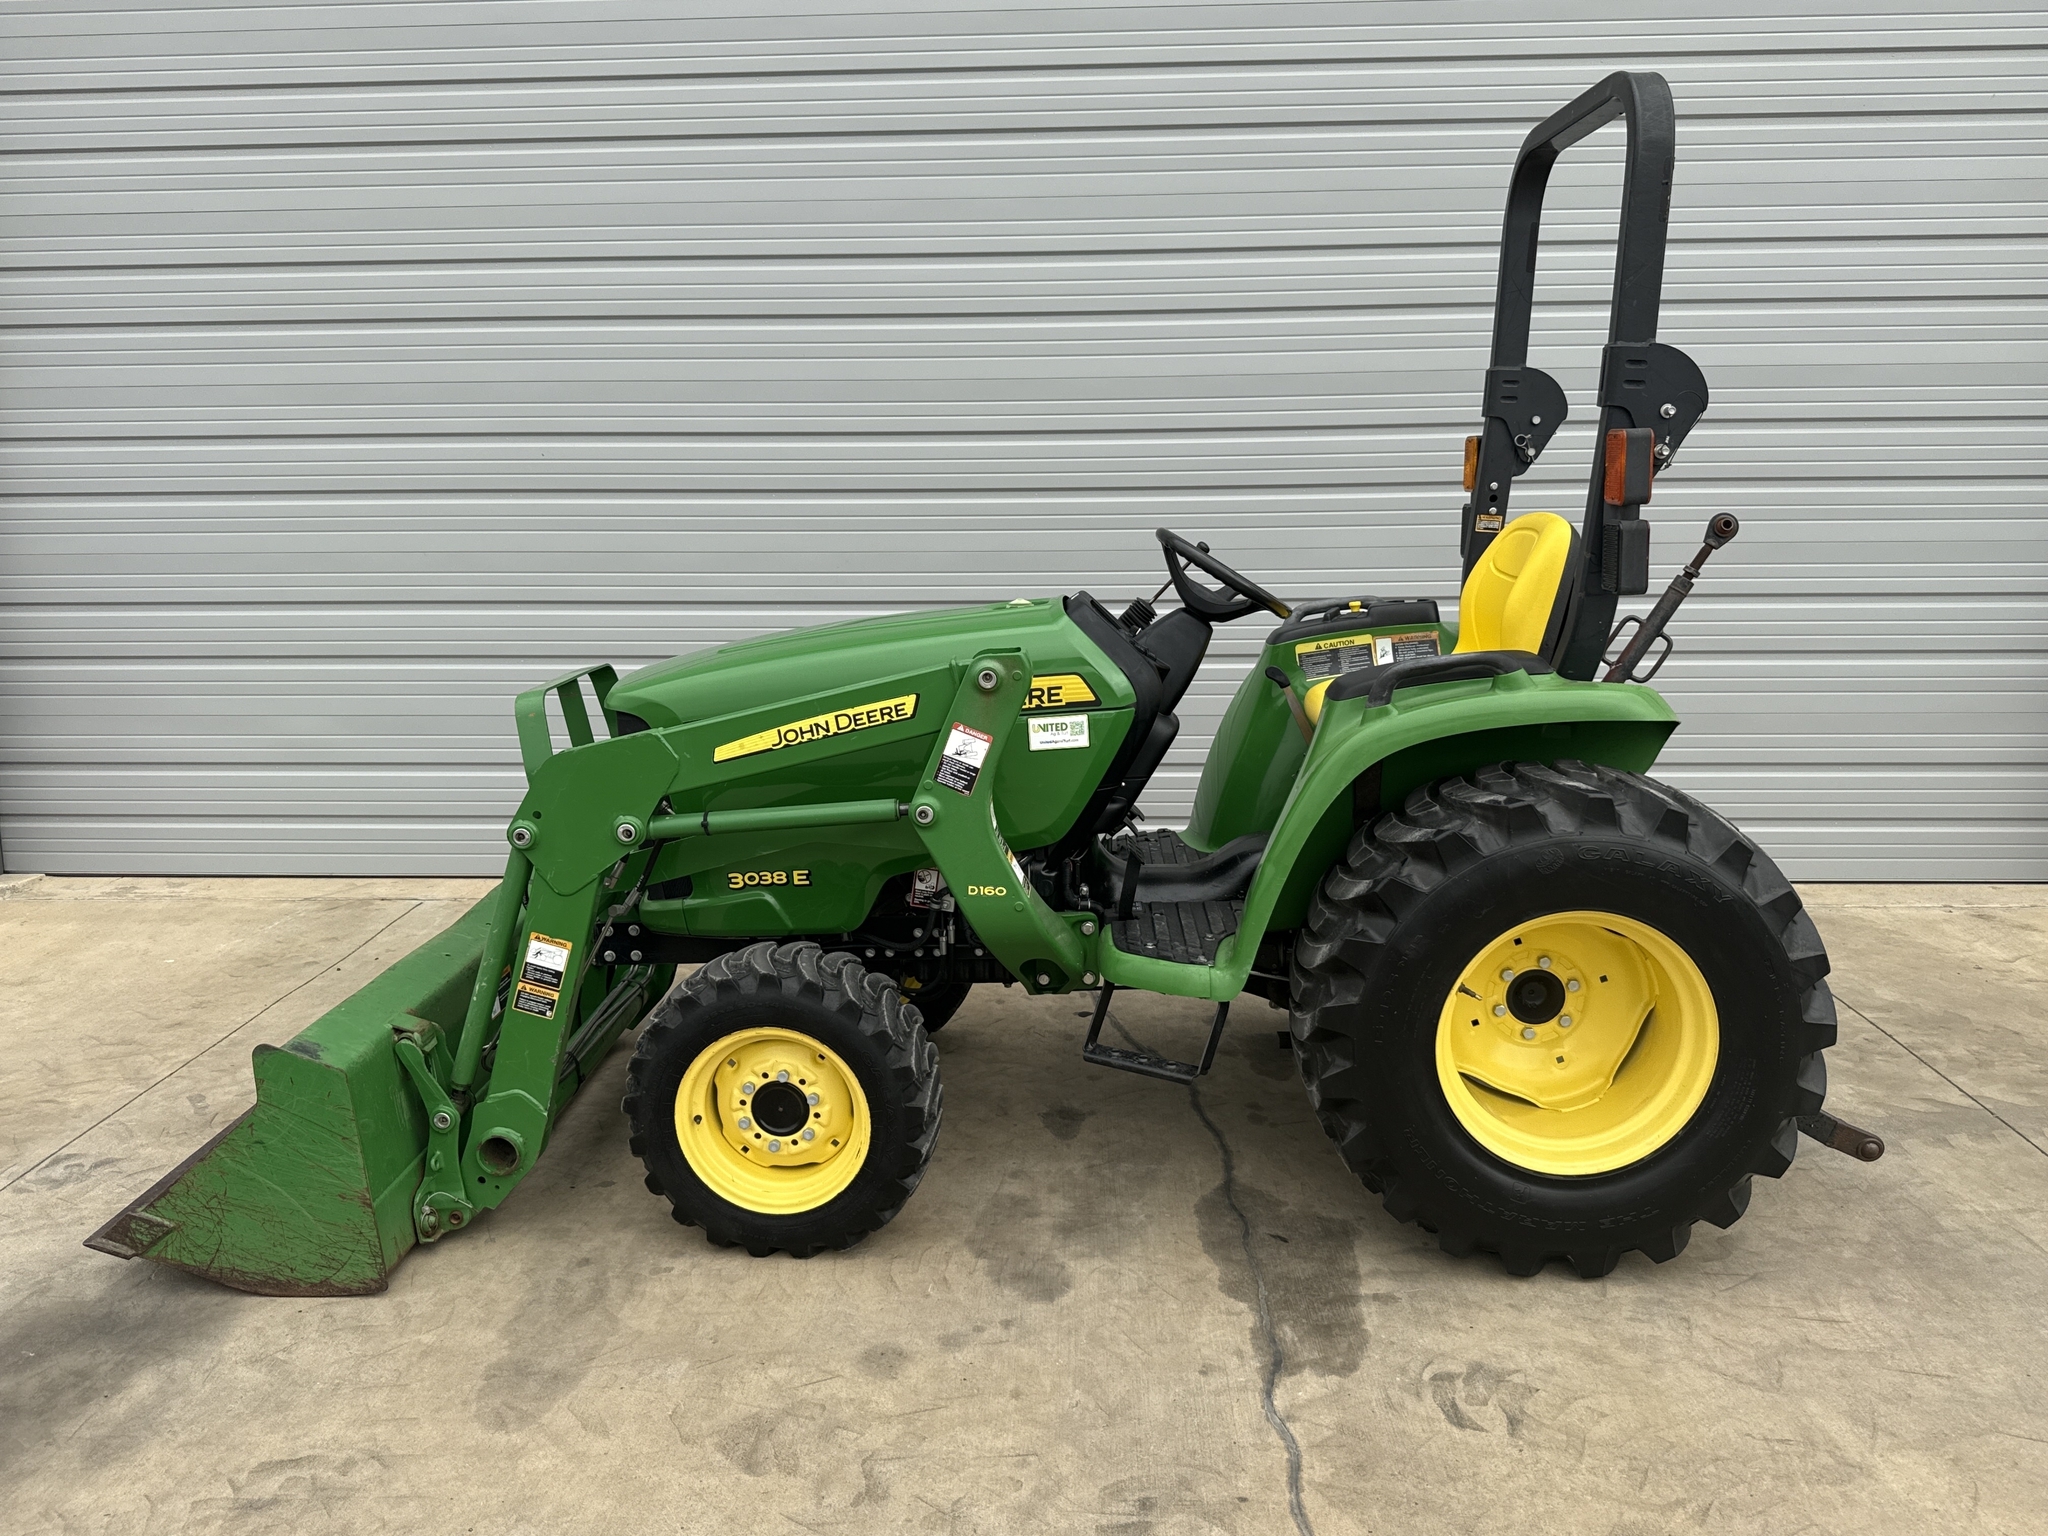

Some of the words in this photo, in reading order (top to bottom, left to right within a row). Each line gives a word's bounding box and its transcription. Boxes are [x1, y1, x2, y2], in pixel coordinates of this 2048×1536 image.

[1323, 639, 1355, 649] CAUTION
[772, 720, 830, 748] JOHN
[834, 702, 909, 732] DEERE
[1032, 722, 1068, 734] UNITED
[965, 728, 989, 741] DANGER
[728, 871, 788, 889] 3038
[792, 870, 810, 885] E
[1577, 846, 1734, 903] GALAXY
[968, 886, 1007, 896] D160
[541, 936, 567, 948] WARNING
[529, 987, 555, 998] WARNING
